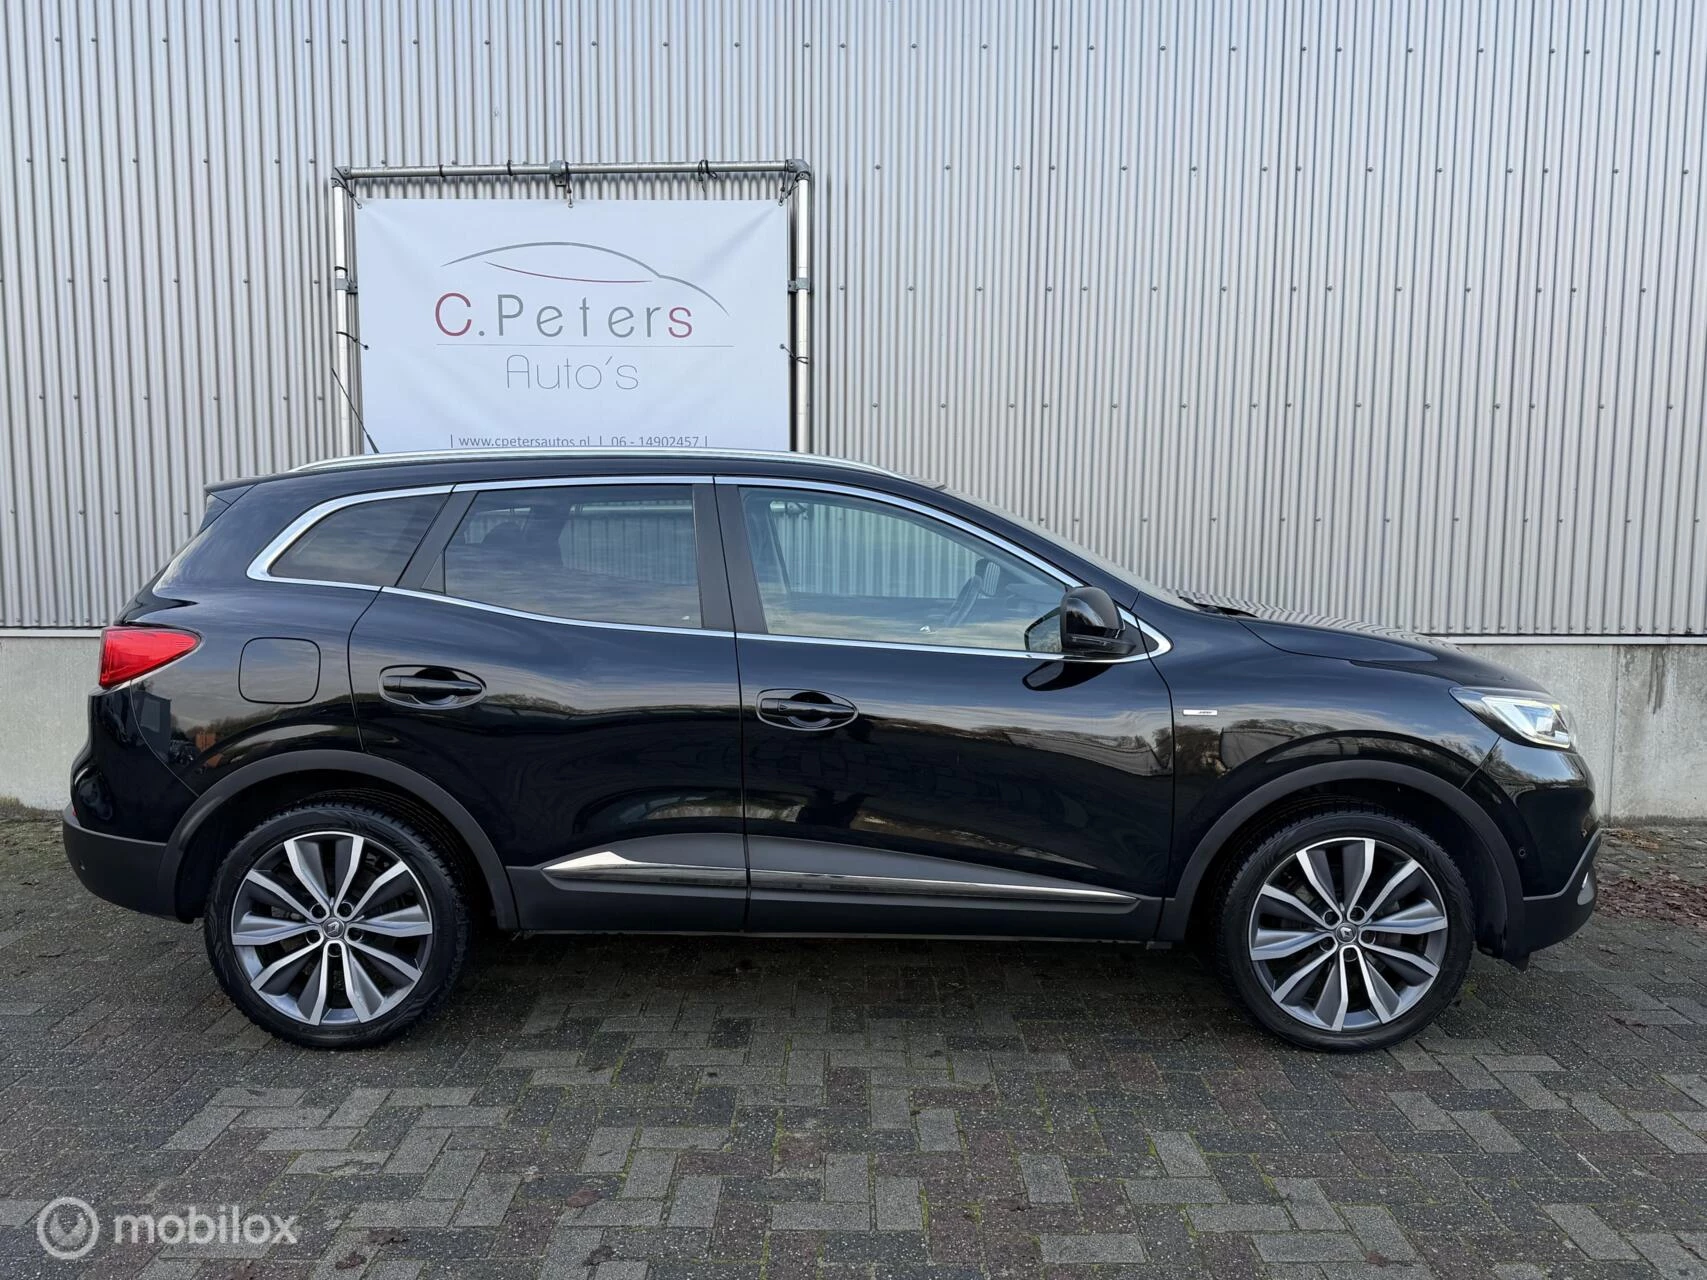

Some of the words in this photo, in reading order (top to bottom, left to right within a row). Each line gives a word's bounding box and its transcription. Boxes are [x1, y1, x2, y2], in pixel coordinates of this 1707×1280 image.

[459, 436, 590, 448] www.cpetersautosnl
[611, 436, 627, 447] 06
[639, 436, 699, 447] 14902457
